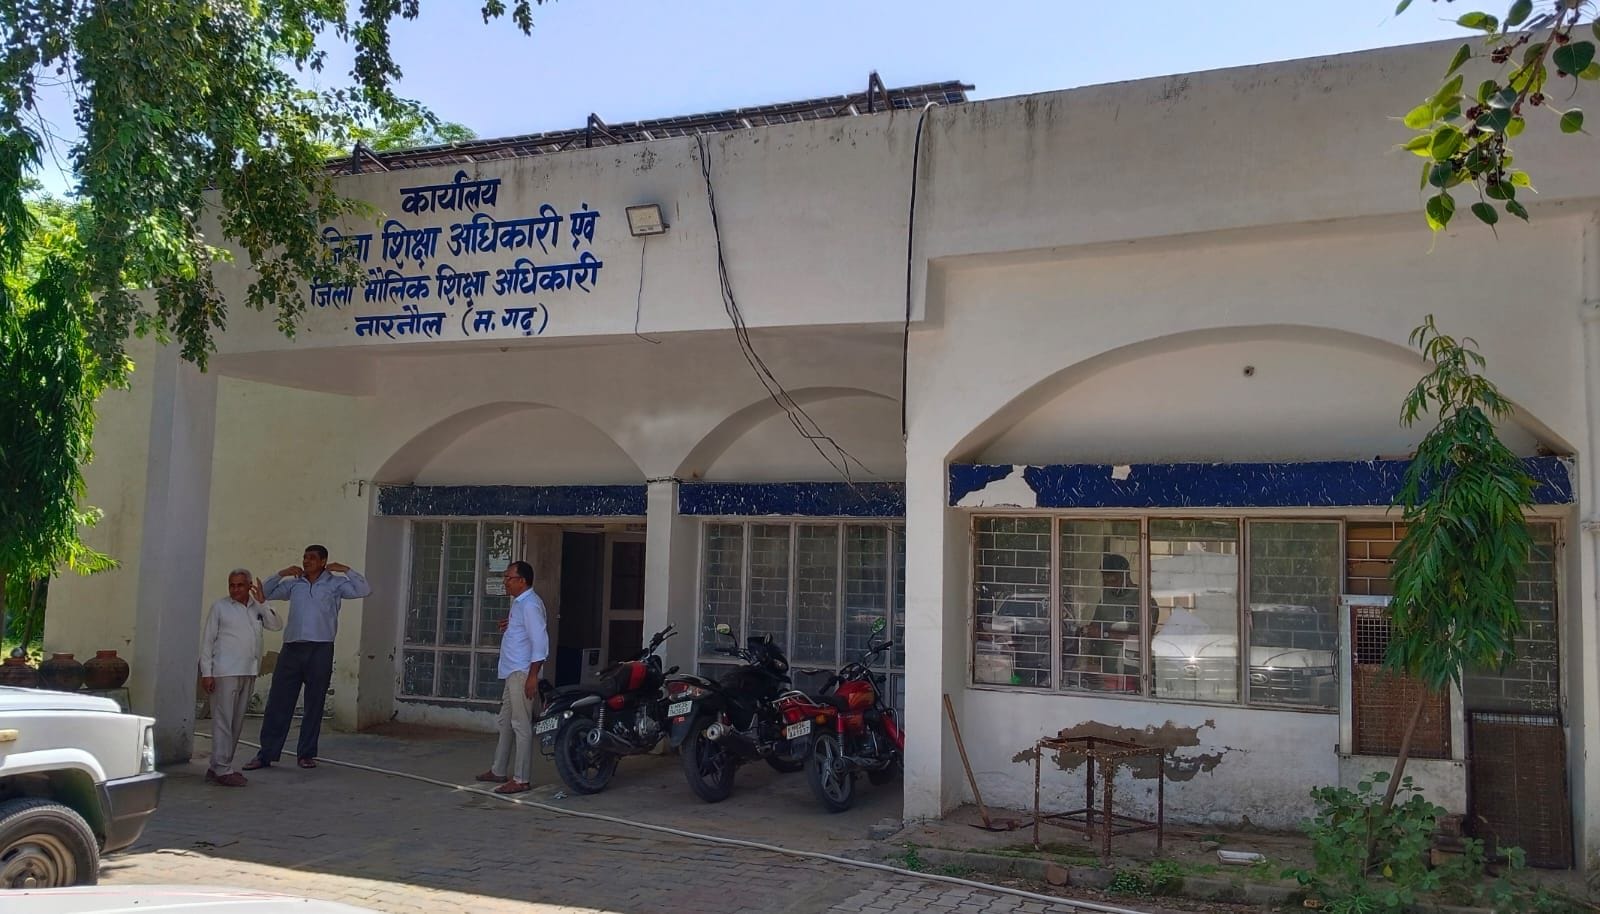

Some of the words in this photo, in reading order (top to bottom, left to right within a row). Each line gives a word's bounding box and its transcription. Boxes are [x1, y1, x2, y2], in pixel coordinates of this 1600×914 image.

[400, 170, 502, 216] कार्यालय
[382, 219, 443, 271] शिक्षा
[447, 203, 563, 257] अधिकारी
[364, 266, 431, 304] मौलिक
[436, 264, 490, 308] शिक्षा
[492, 251, 604, 297] अधिकारी
[354, 304, 447, 339] नारनौल
